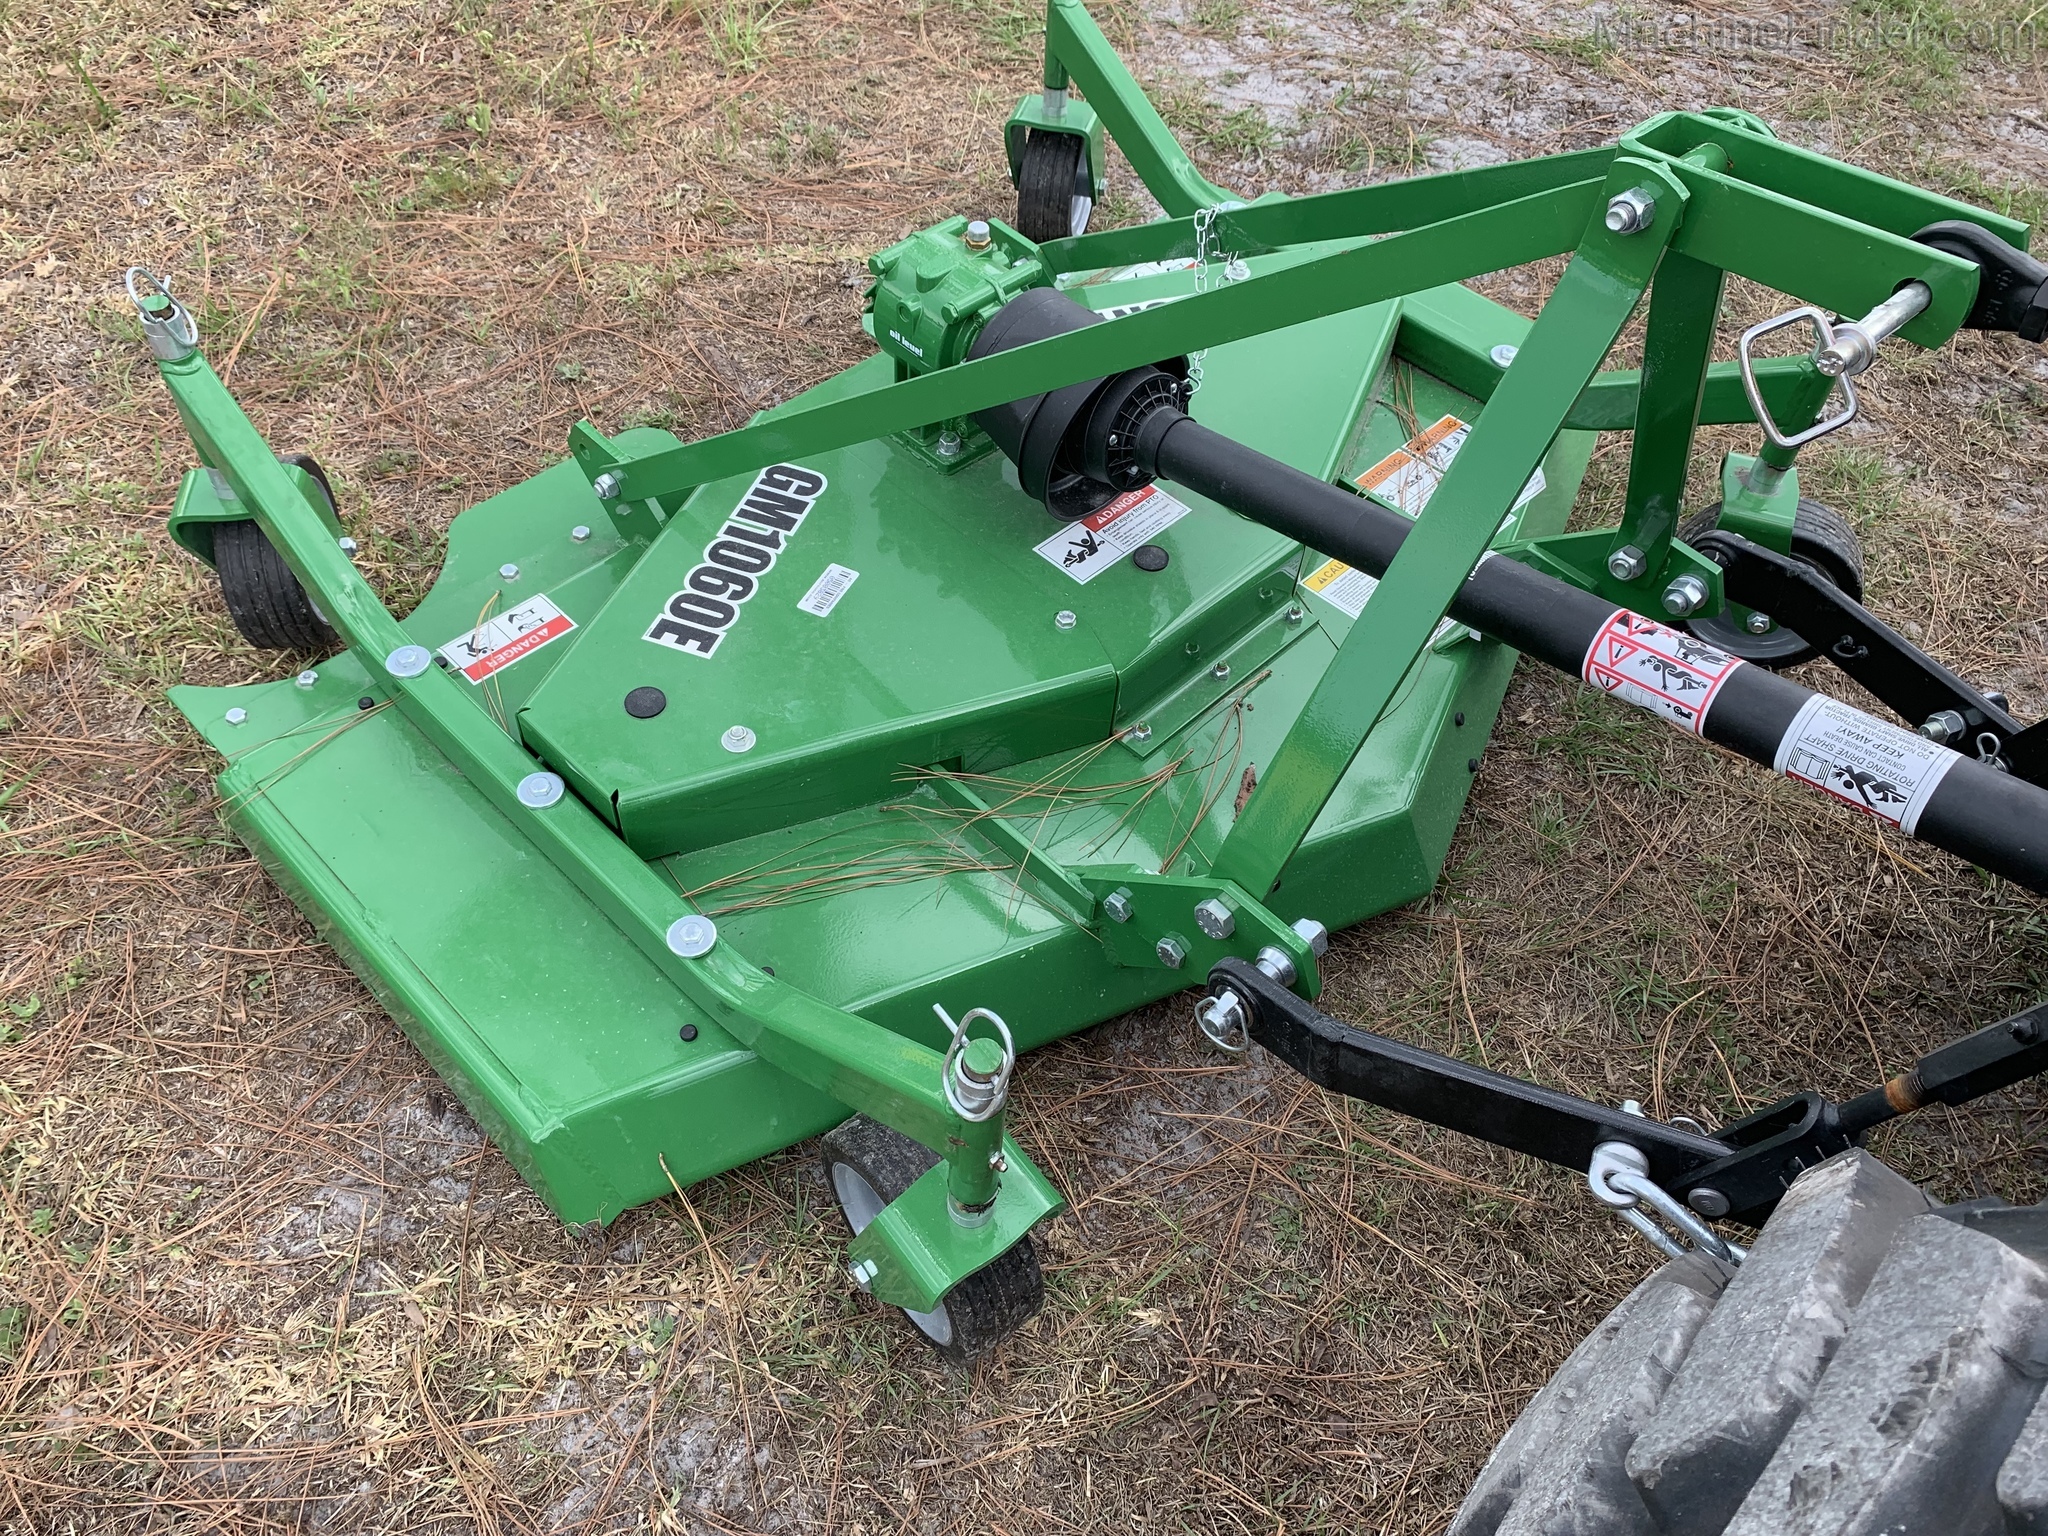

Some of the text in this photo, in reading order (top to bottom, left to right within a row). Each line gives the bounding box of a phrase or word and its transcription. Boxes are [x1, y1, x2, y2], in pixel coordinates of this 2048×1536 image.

[889, 329, 923, 358] oil level
[1102, 522, 1119, 534] Avoid
[1118, 510, 1134, 526] injury
[1133, 503, 1148, 516] from
[1103, 490, 1146, 519] DANGER
[648, 465, 823, 655] GM1060E
[486, 634, 540, 667] DANGER
[1822, 729, 1906, 771] CONTACT CAN CAUSE DEATH
[1835, 724, 1904, 759] KEEP AWAY!
[1860, 726, 1898, 746] OPERATE
[1897, 742, 1916, 754] NOT
[1803, 732, 1916, 787] ROTATING DRIVE SHAFT
[1915, 750, 1930, 760] DO
